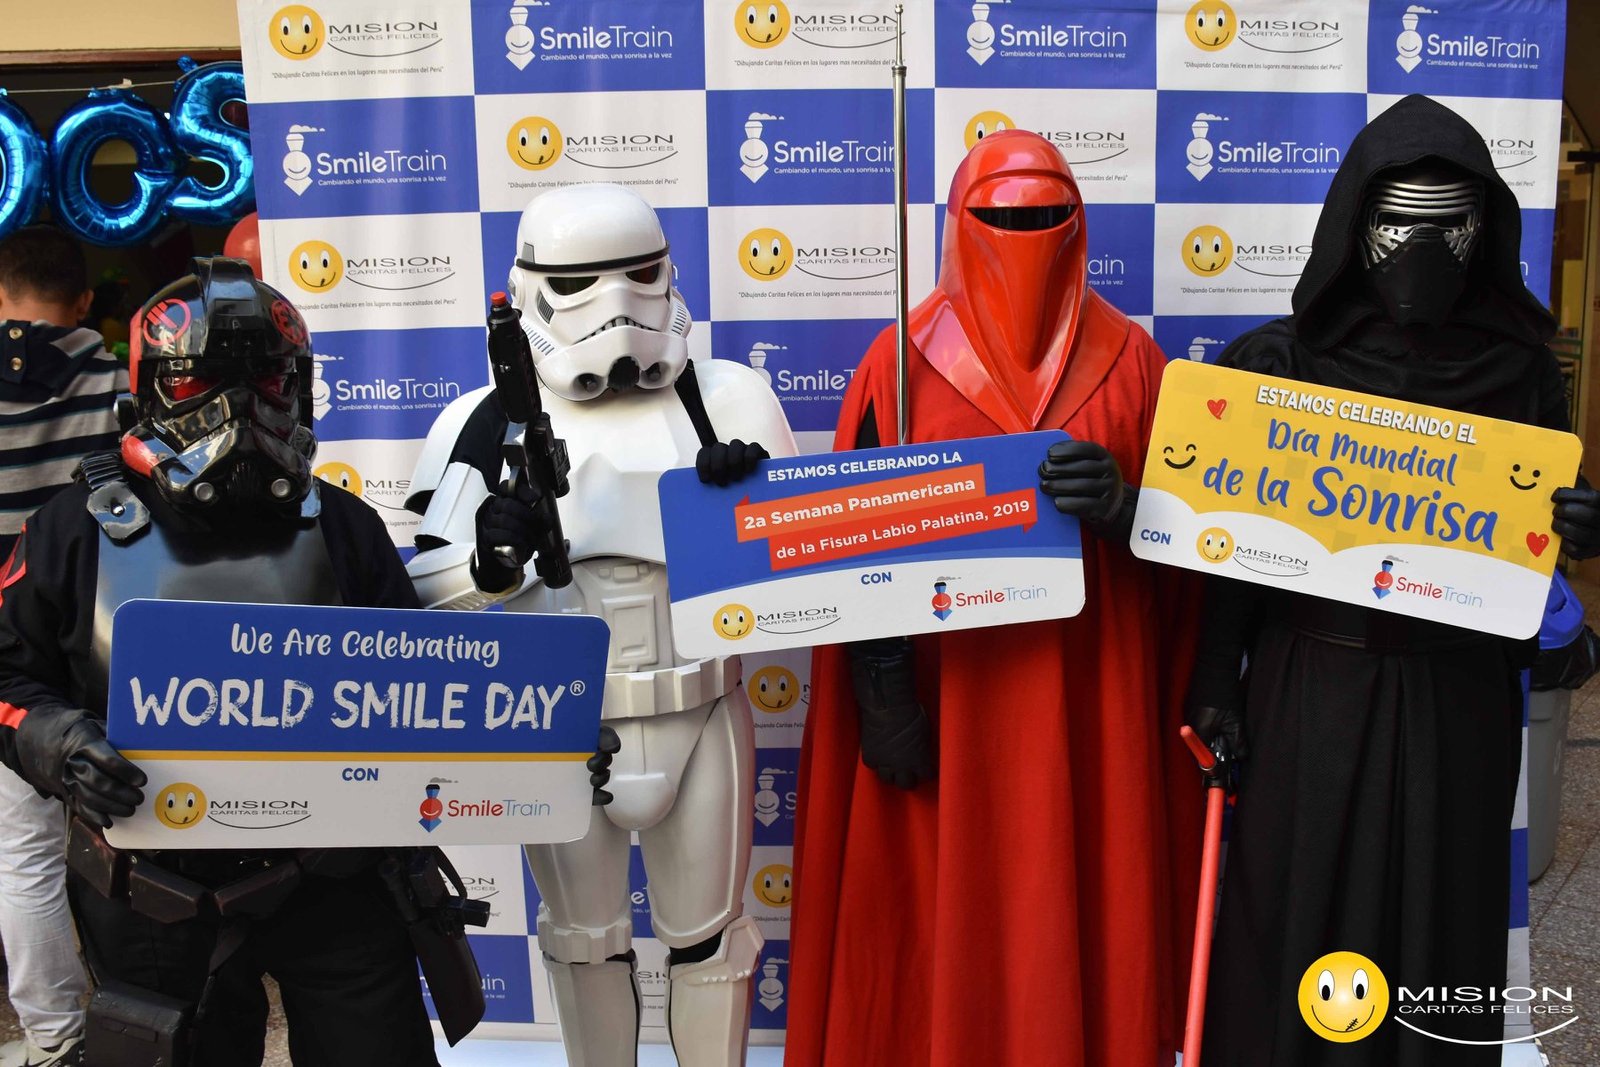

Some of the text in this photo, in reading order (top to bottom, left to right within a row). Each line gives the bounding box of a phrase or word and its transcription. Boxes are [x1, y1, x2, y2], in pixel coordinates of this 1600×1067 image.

[329, 22, 437, 34] MISION
[1001, 24, 1126, 47] SmileTrain
[1241, 21, 1339, 30] MISION
[541, 26, 672, 49] SmileTrain
[1427, 34, 1539, 59] SmileTrain
[567, 135, 673, 146] MISION
[317, 150, 446, 175] SmileTrain
[1219, 141, 1339, 163] SmileTrain
[347, 256, 450, 268] MISION
[336, 378, 460, 401] SmileTrain
[777, 369, 856, 391] SmileT
[1257, 385, 1477, 444] ESTAMOS CELEBRANDO EL
[768, 451, 962, 482] ESTAMOS CELEBRANDO LA
[366, 480, 411, 488] MIS
[744, 479, 975, 530] 2a Semana Panamericana
[1203, 458, 1498, 551] de la Sonrisa
[776, 500, 1030, 558] de la Fisura Labio Palatina, 2019
[1141, 529, 1171, 545] CON
[1236, 546, 1308, 567] MISION
[1236, 553, 1307, 572] CARITAS FELICES
[861, 572, 892, 585] CON
[956, 585, 1047, 606] SmileTrain
[1396, 576, 1482, 608] SmileTrain
[757, 607, 837, 621] MISION
[231, 623, 500, 668] We Are Celebrating
[130, 676, 314, 729] WORLD
[331, 680, 469, 729] SMILE
[342, 768, 379, 781] CON
[210, 801, 308, 809] MISION
[448, 799, 550, 817] SmileTrain
